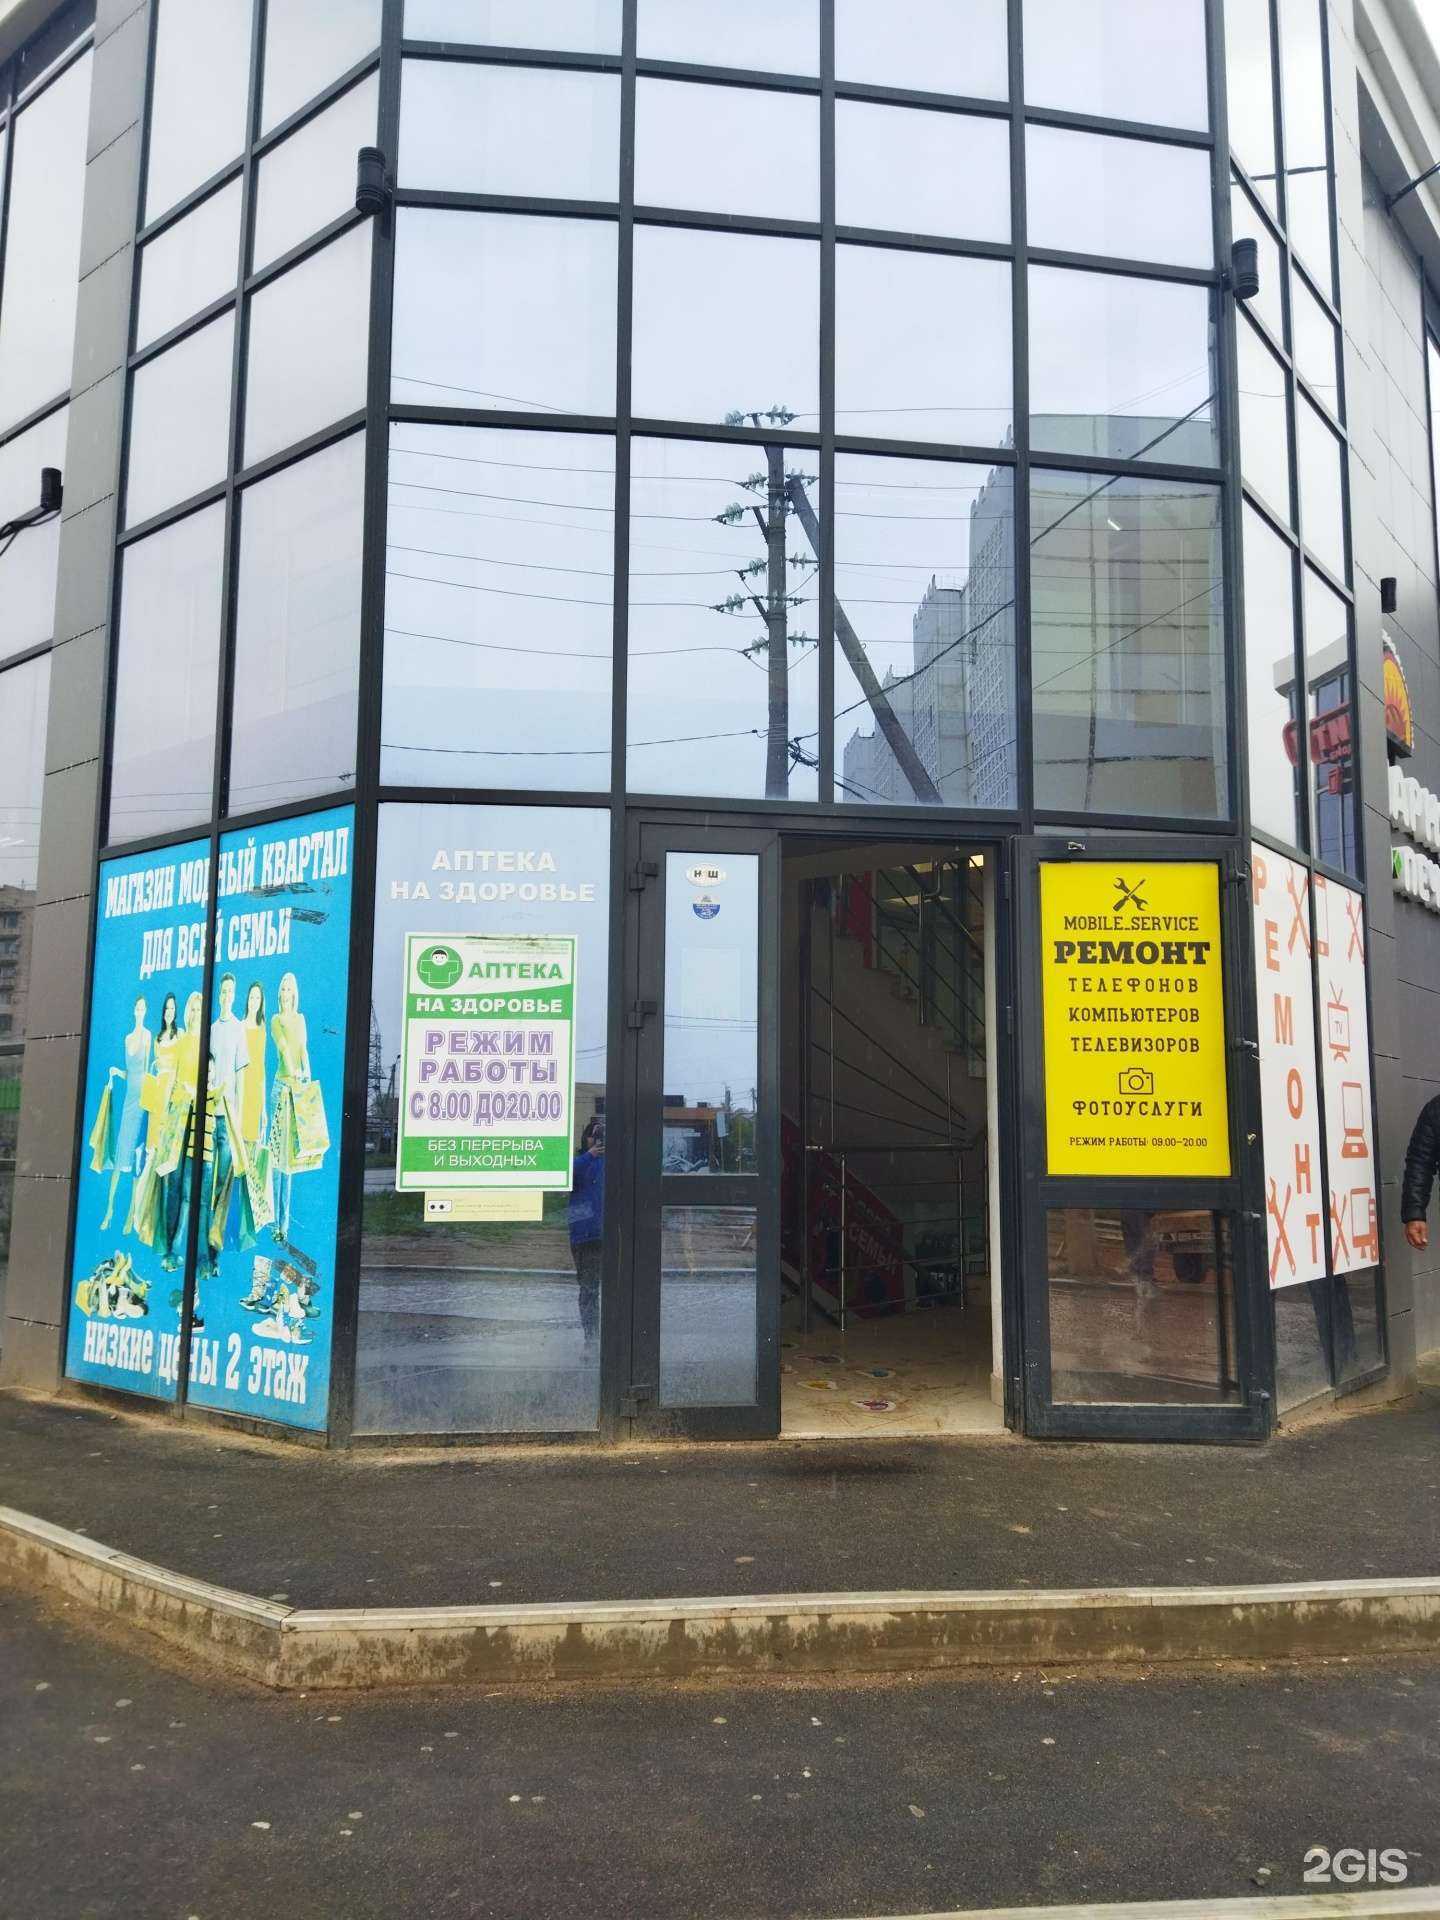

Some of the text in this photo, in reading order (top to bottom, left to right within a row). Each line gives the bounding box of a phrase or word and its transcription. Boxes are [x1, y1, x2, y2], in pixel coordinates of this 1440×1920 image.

[431, 850, 557, 872] АПТЕКА
[104, 864, 176, 918] МАГАЗИН
[261, 827, 350, 886] КВАРТАЛ
[390, 880, 596, 903] НА ЗДОРОВЬЕ
[140, 928, 172, 980] ДЛЯ
[228, 907, 292, 961] СЕМЬИ
[1054, 941, 1210, 964] РЕМОНТ
[468, 962, 564, 979] АПТЕКА
[1068, 978, 1198, 992] ТЕЛЕФОНОВ
[416, 998, 562, 1015] НА ЗДОРОВЬЕ
[1069, 1008, 1200, 1022] КОМПЬЮТЕРОВ
[424, 1030, 554, 1055] РЕЖИМ
[1071, 1038, 1200, 1052] ТЕЛЕВИЗОРОВ
[418, 1059, 557, 1083] РАБОТЫ
[410, 1090, 425, 1120] С
[1072, 1101, 1202, 1116] ФОТОУСЛУГИ
[428, 1140, 544, 1151] БЕЗ ПЕРЕРЫВА
[1069, 1137, 1106, 1146] РЕЖИМ
[434, 1155, 537, 1168] И ВЫХОДНЫХ
[225, 1332, 242, 1391] 2
